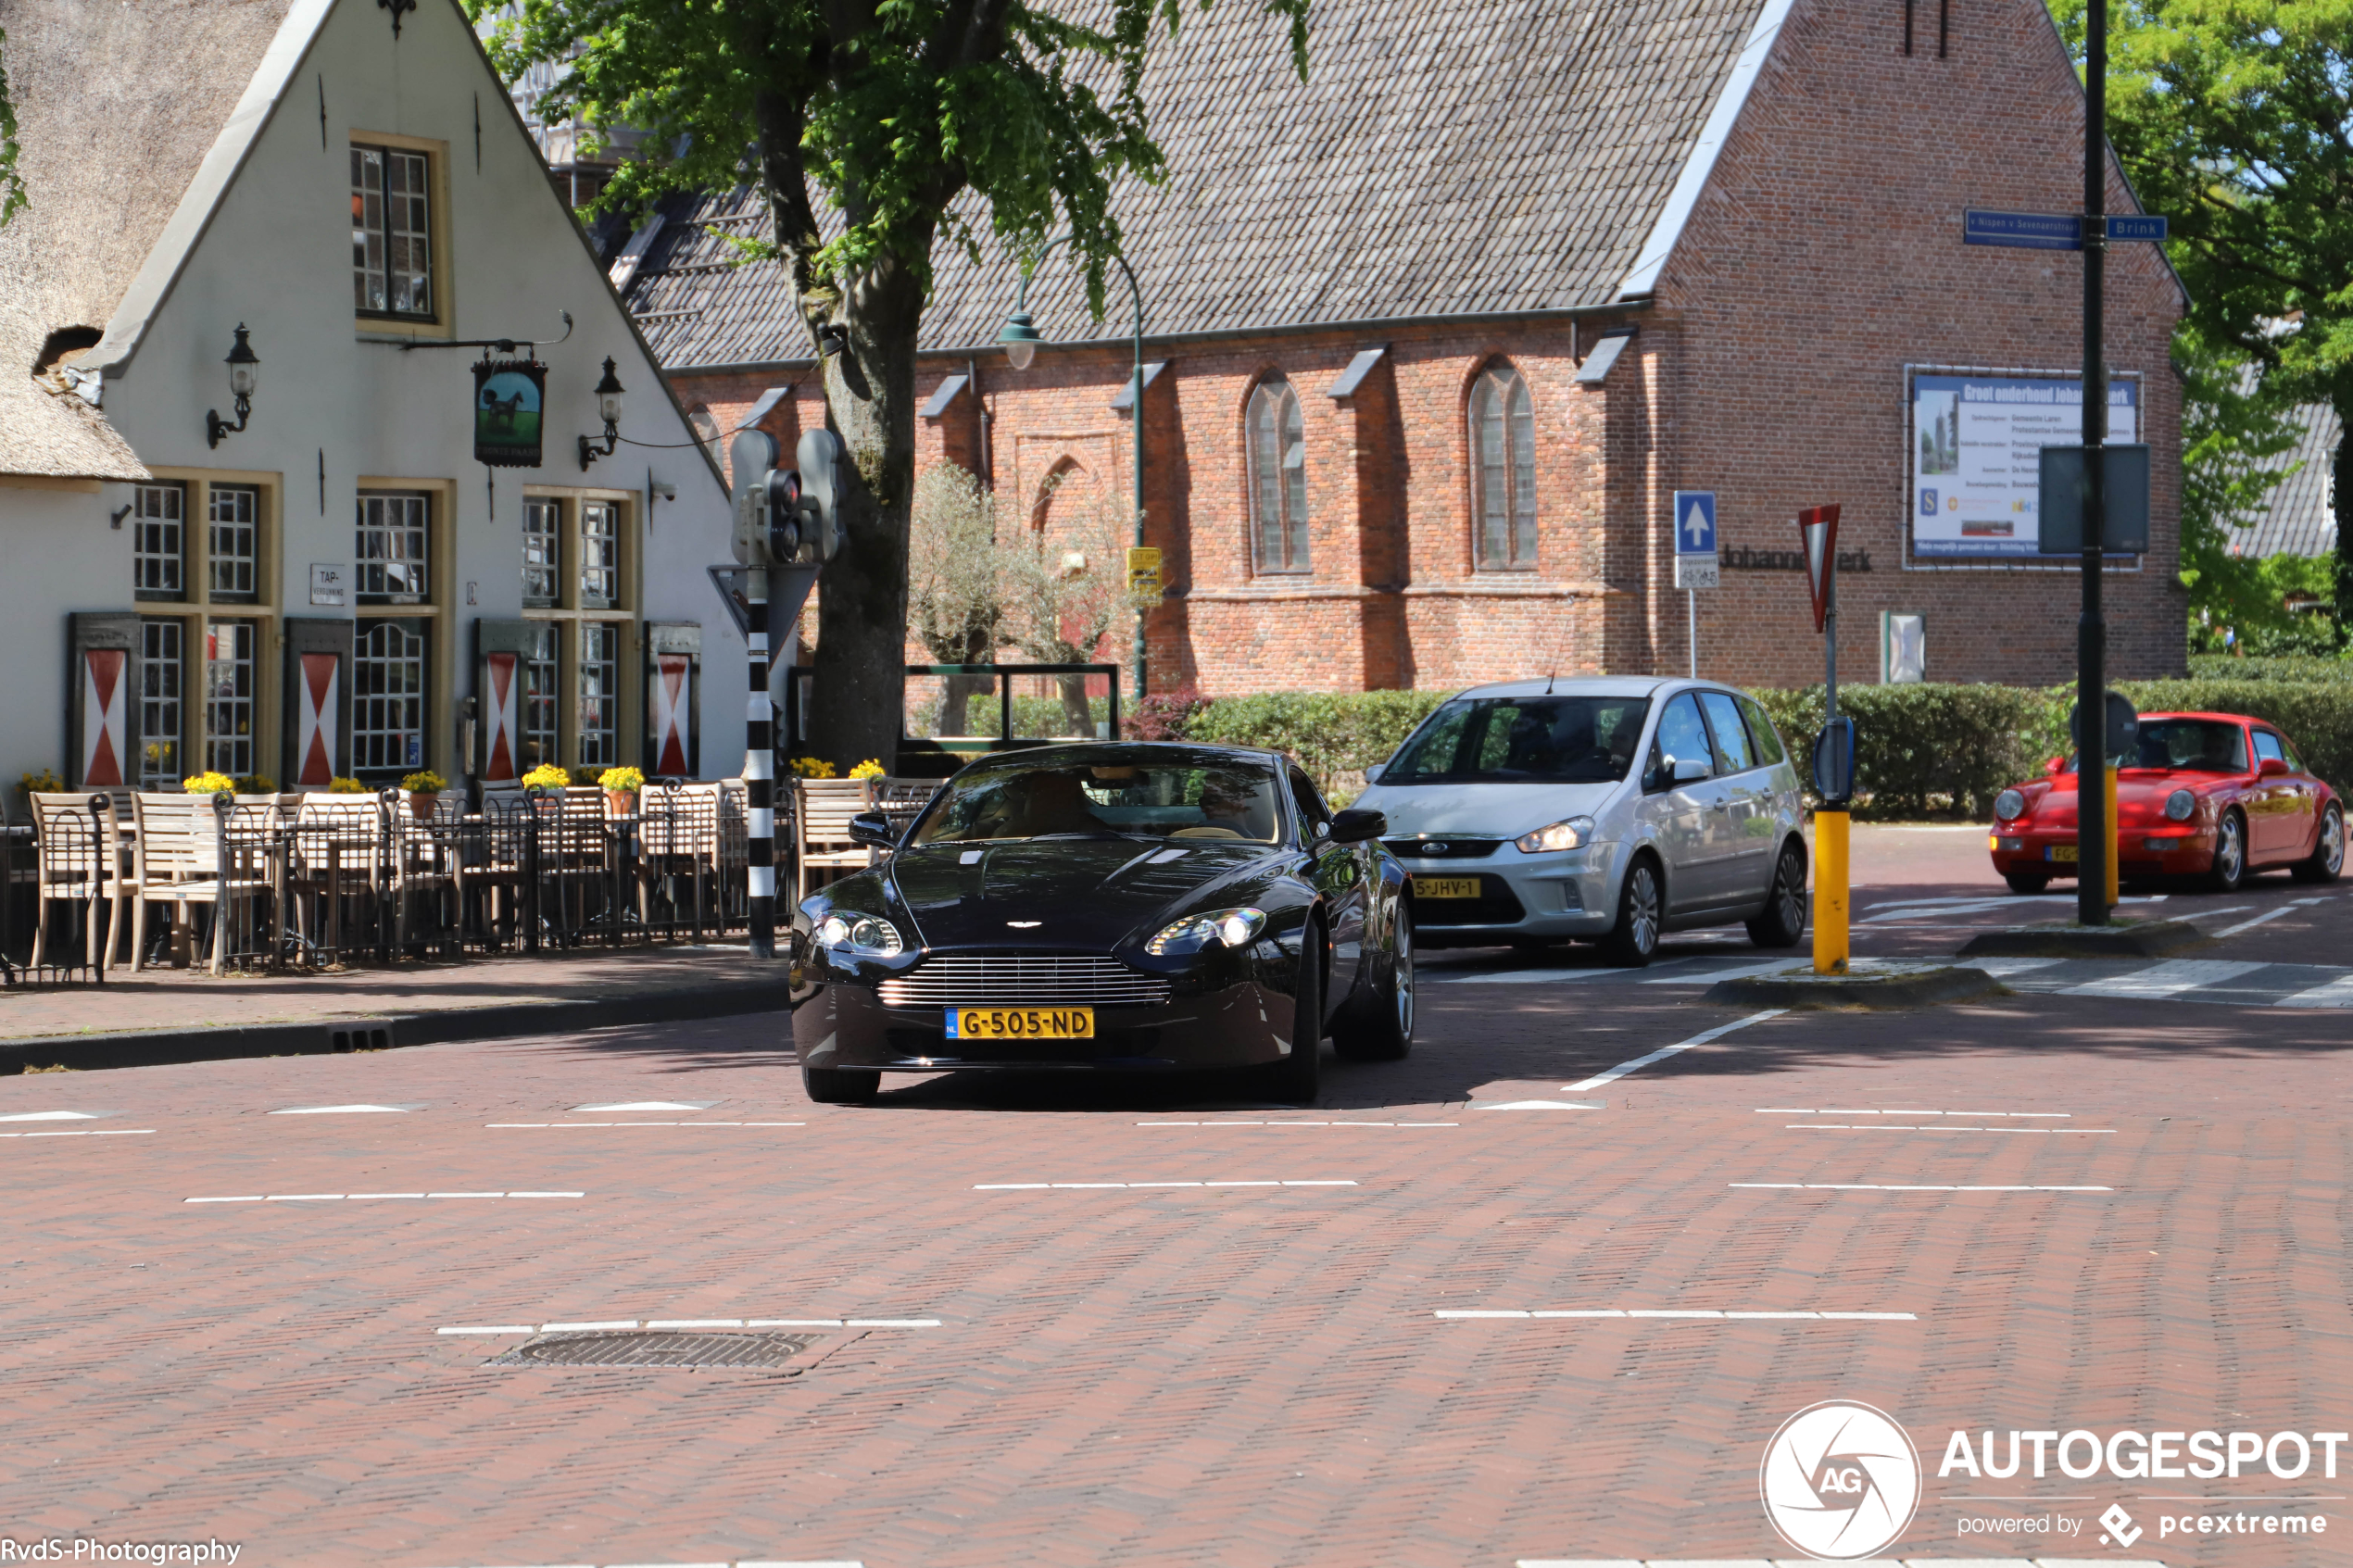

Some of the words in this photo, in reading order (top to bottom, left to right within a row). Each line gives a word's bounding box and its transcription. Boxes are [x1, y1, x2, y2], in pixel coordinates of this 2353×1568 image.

[1978, 217, 2006, 228] Nispen
[2017, 219, 2078, 232] Sevenaerstraat
[2116, 222, 2157, 234] Brink
[1964, 383, 1994, 402] Groot
[1994, 385, 2054, 403] onderhoud
[2044, 414, 2062, 422] Laren
[2011, 425, 2051, 433] Protestantse
[510, 447, 541, 457] PAARD
[1679, 558, 1717, 567] uitgezonderd
[320, 571, 339, 583] TAP-
[313, 587, 344, 596] VERGUNNING
[946, 1025, 957, 1034] NL
[964, 1011, 1088, 1035] G-505-ND
